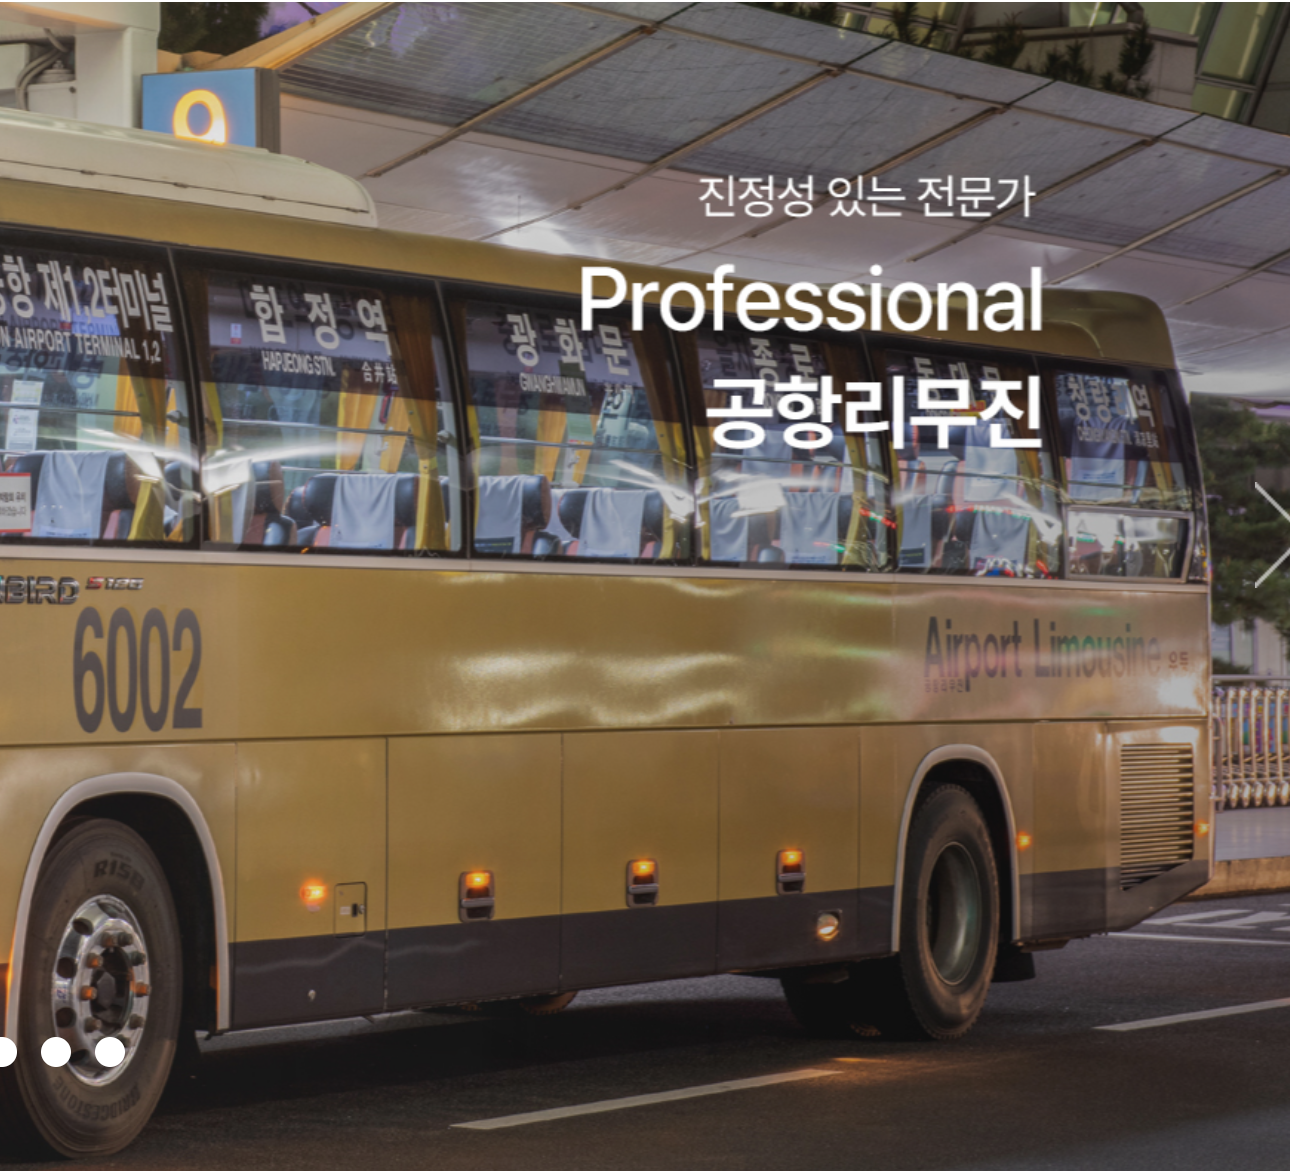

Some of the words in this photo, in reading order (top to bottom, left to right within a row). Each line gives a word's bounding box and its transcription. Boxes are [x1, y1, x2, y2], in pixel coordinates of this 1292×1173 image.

[36, 260, 175, 333] 제1,2터미널
[249, 284, 393, 356] 합정역
[14, 326, 72, 353] AIRPORT
[74, 332, 141, 361] TERMINAL
[142, 340, 163, 364] 1,2
[261, 350, 314, 373] HAPJEONG
[506, 313, 630, 377] 광화문
[73, 606, 203, 734] 6002
[924, 615, 1023, 692] Airport
[1033, 618, 1162, 678] Limousine
